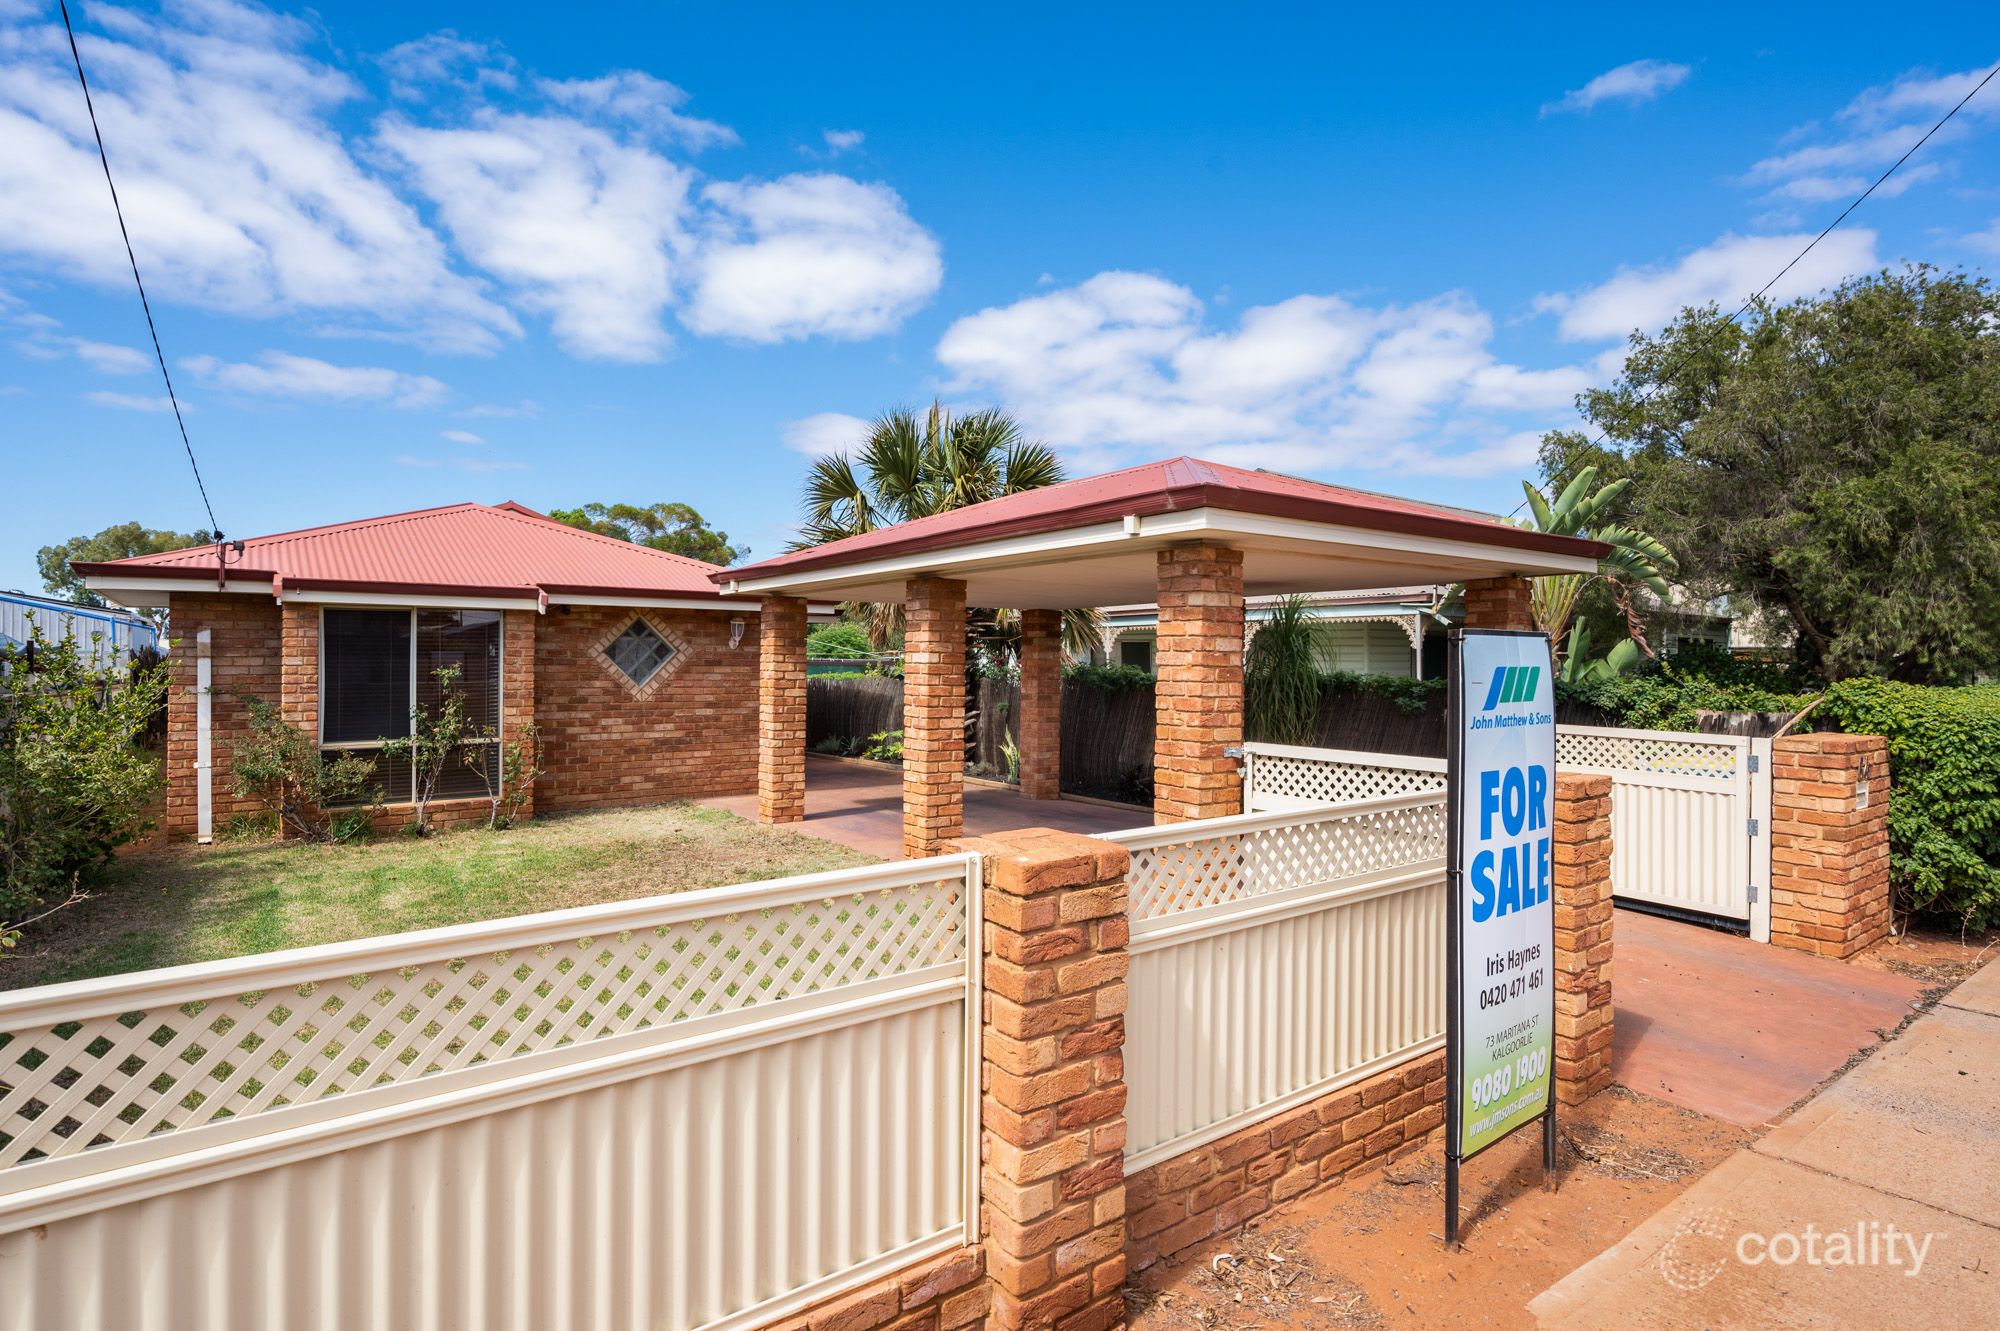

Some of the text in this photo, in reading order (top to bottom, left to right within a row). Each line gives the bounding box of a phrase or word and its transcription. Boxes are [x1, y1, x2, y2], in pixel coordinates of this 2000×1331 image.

[1470, 712, 1552, 730] John Matthew & Sons
[1480, 764, 1547, 841] FOR
[1470, 837, 1549, 923] SALE
[1486, 943, 1541, 977] Iris Haynes
[1480, 967, 1544, 1010] 0420 471 461
[1486, 1014, 1539, 1049] 73 MARITANA ST
[1492, 1032, 1533, 1061] KALGOORLIE
[1472, 1045, 1546, 1112] 9080 1900
[1470, 1086, 1544, 1138] www.jmsons.com.au
